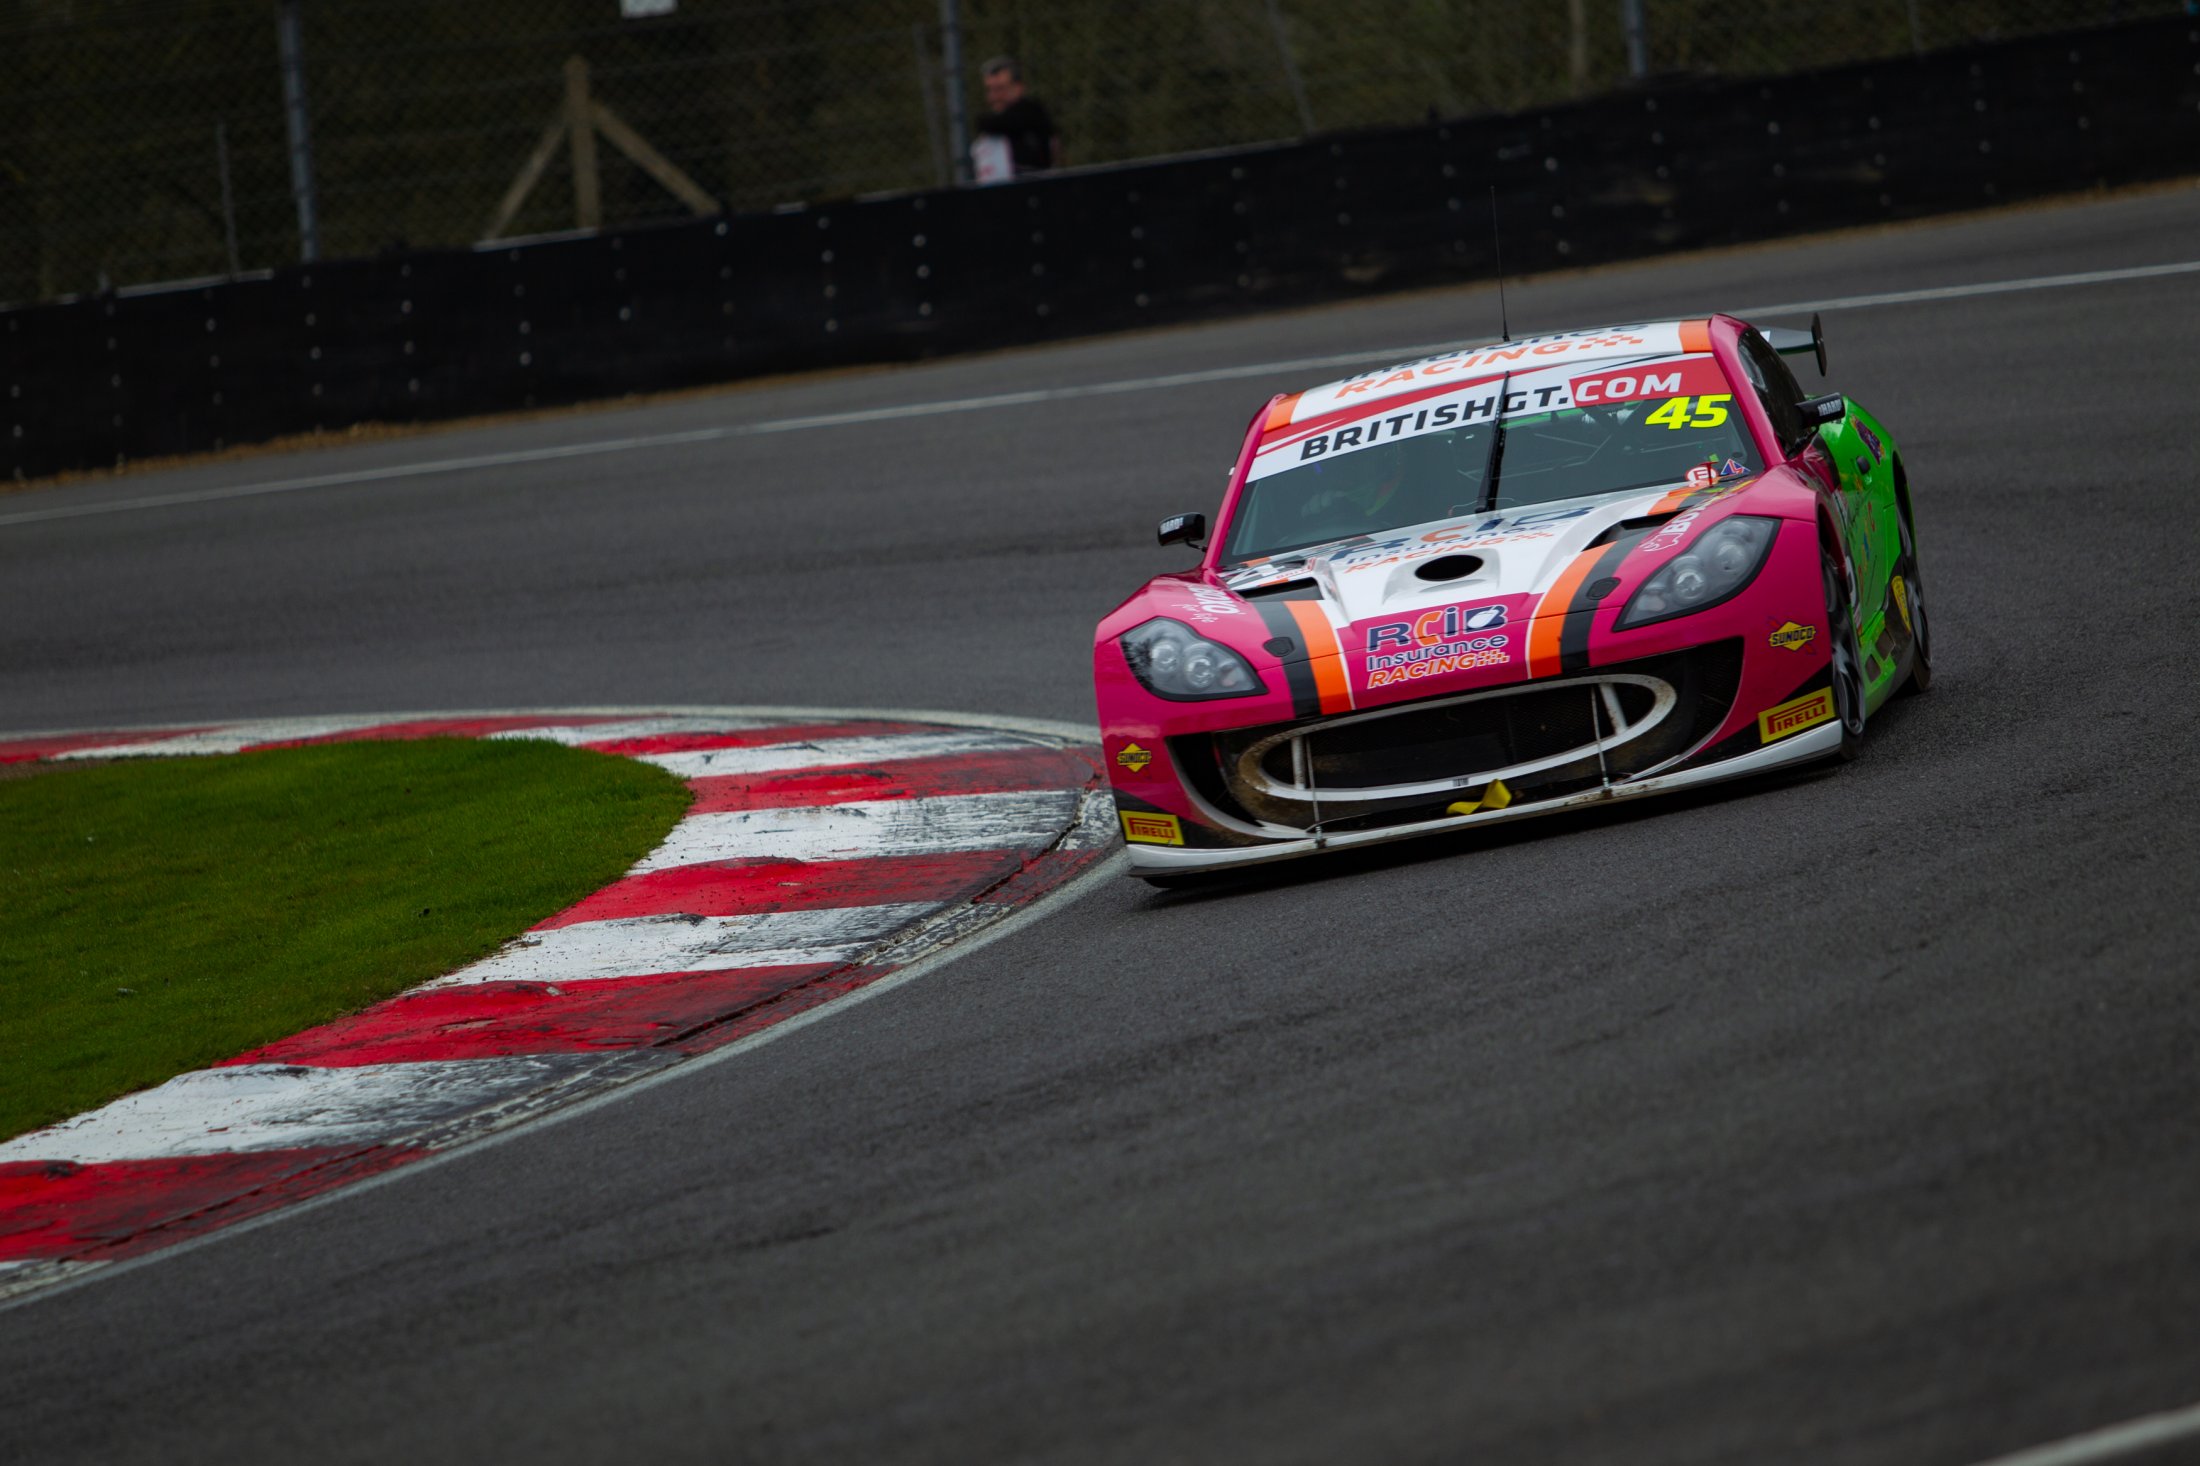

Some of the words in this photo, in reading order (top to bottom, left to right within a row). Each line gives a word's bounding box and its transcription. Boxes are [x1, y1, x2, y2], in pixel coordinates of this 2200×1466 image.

[1335, 340, 1576, 399] RACING
[1300, 372, 1682, 461] BRITISHGT.COM
[1645, 394, 1732, 429] 45
[1345, 537, 1506, 574] RACING
[1347, 524, 1555, 565] Insurance
[1367, 635, 1508, 671] Insurance
[1772, 627, 1813, 645] SUNOCO
[1367, 652, 1477, 689] RACING
[1767, 695, 1826, 735] PIRELLI
[1127, 817, 1176, 839] PIRELLI
